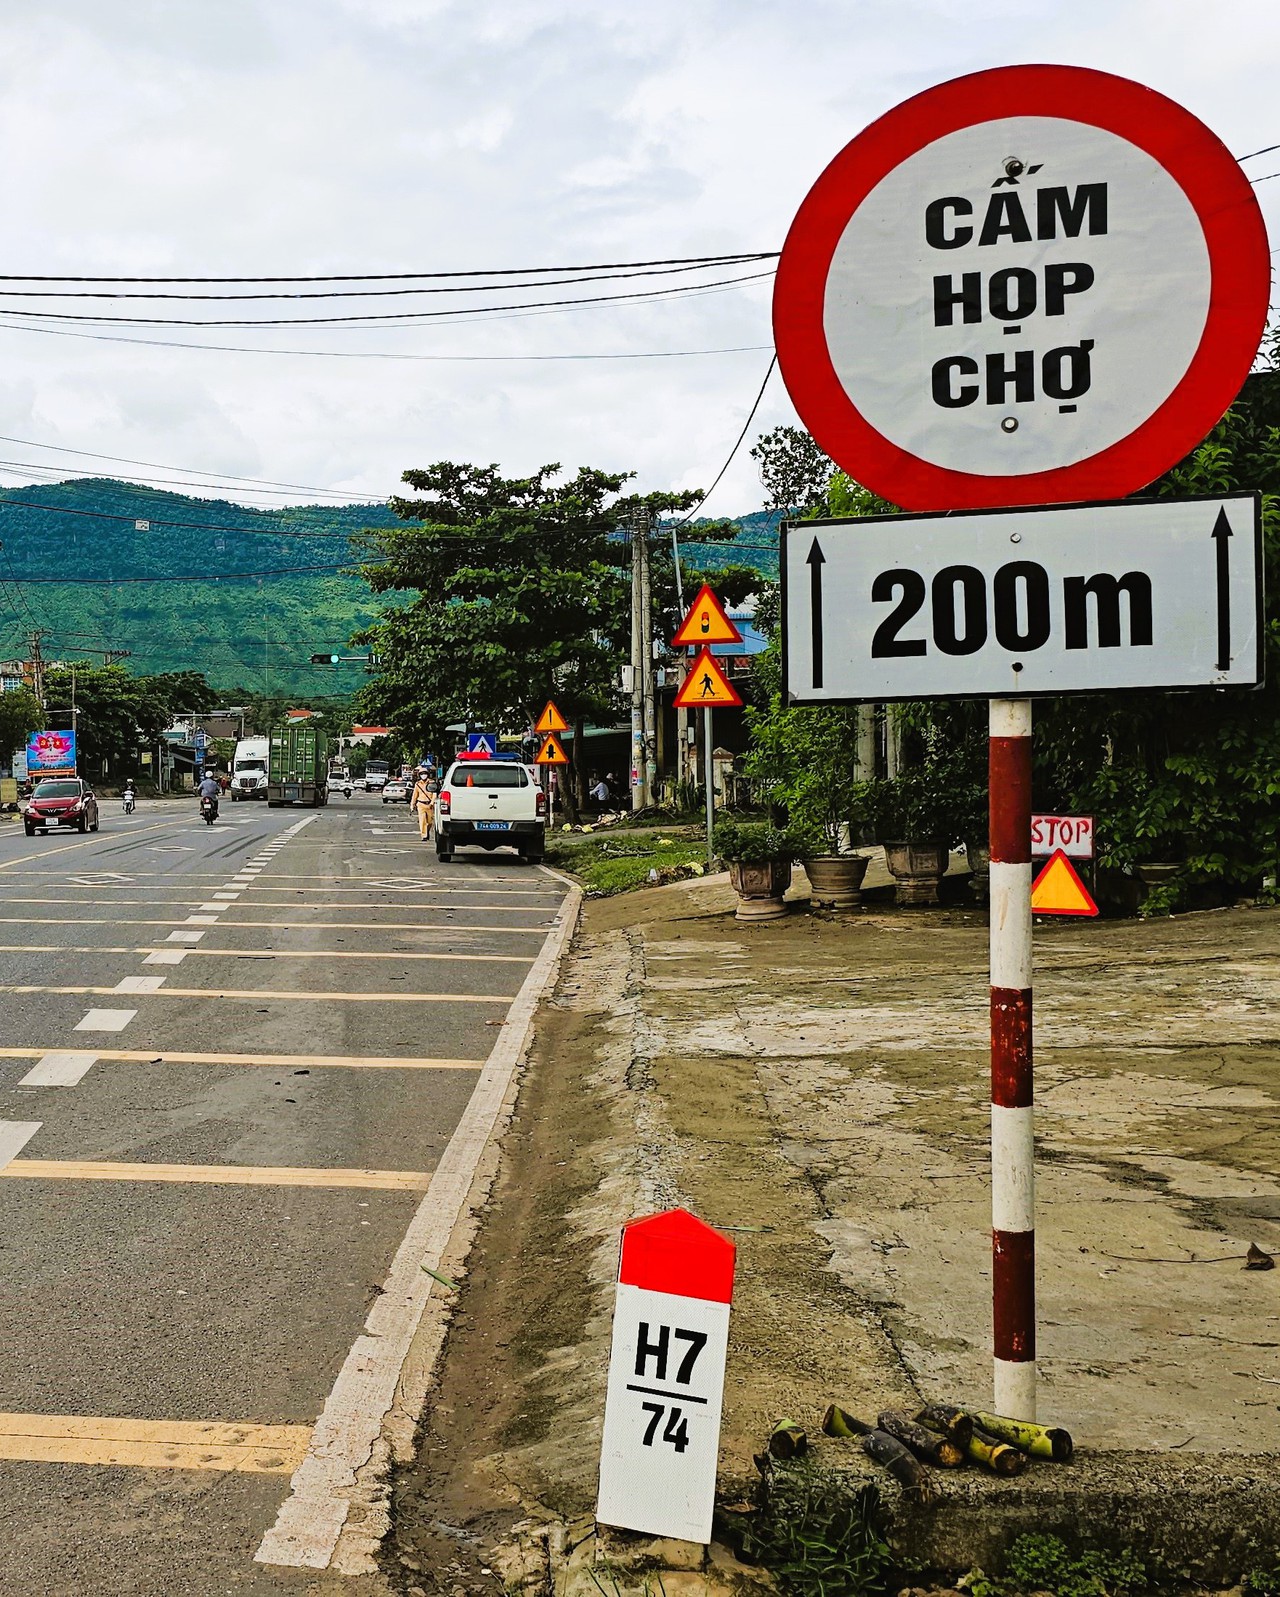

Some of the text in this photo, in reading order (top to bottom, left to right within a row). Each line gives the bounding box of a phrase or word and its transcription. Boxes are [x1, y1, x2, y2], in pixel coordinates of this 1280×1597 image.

[926, 163, 1108, 250] CẤM
[933, 262, 1095, 335] HỌP
[931, 339, 1095, 414] CHỢ
[871, 560, 1153, 659] 200m
[1031, 818, 1090, 847] STOP
[634, 1321, 708, 1385] H7
[641, 1401, 690, 1454] 74
